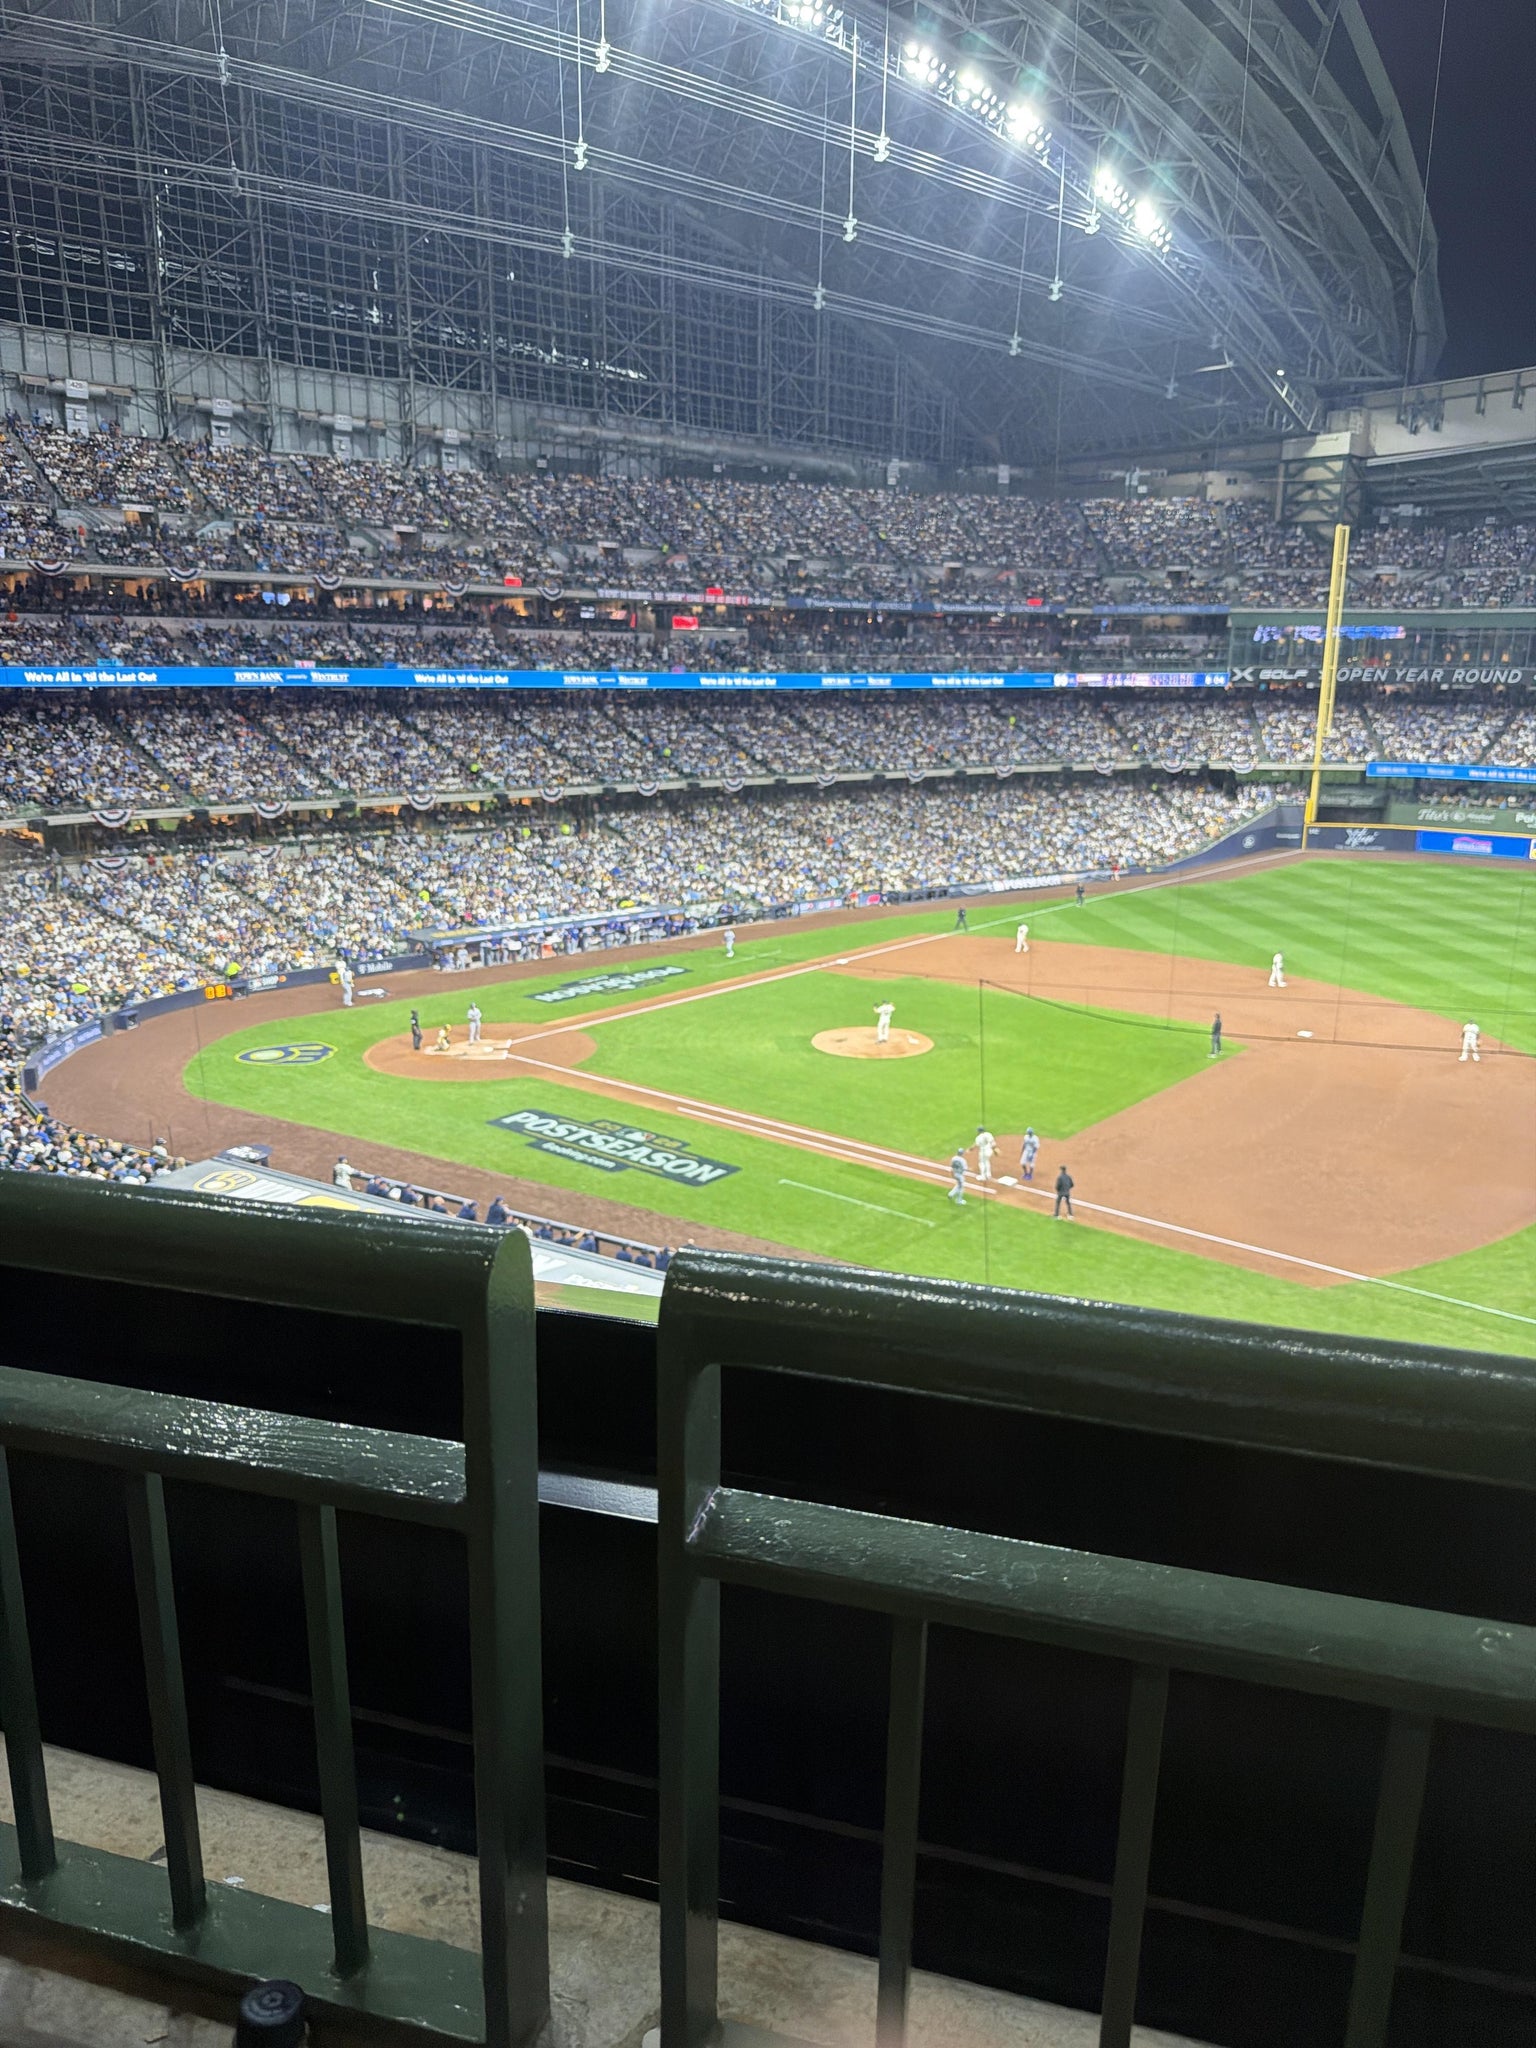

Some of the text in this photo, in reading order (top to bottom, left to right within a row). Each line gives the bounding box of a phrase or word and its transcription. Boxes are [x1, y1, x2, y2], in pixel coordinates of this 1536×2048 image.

[24, 671, 54, 682] We're
[55, 671, 70, 682] All
[71, 671, 82, 682] In
[98, 671, 115, 682] the
[116, 671, 136, 682] Last
[138, 671, 157, 682] Out
[494, 673, 508, 684] Out
[1259, 669, 1309, 680] GOLF
[1336, 668, 1388, 682] OPEN
[1395, 668, 1444, 683] YEAR
[1452, 668, 1523, 684] ROUND
[367, 961, 393, 974] Mobile
[501, 1112, 727, 1182] POSTSEASON
